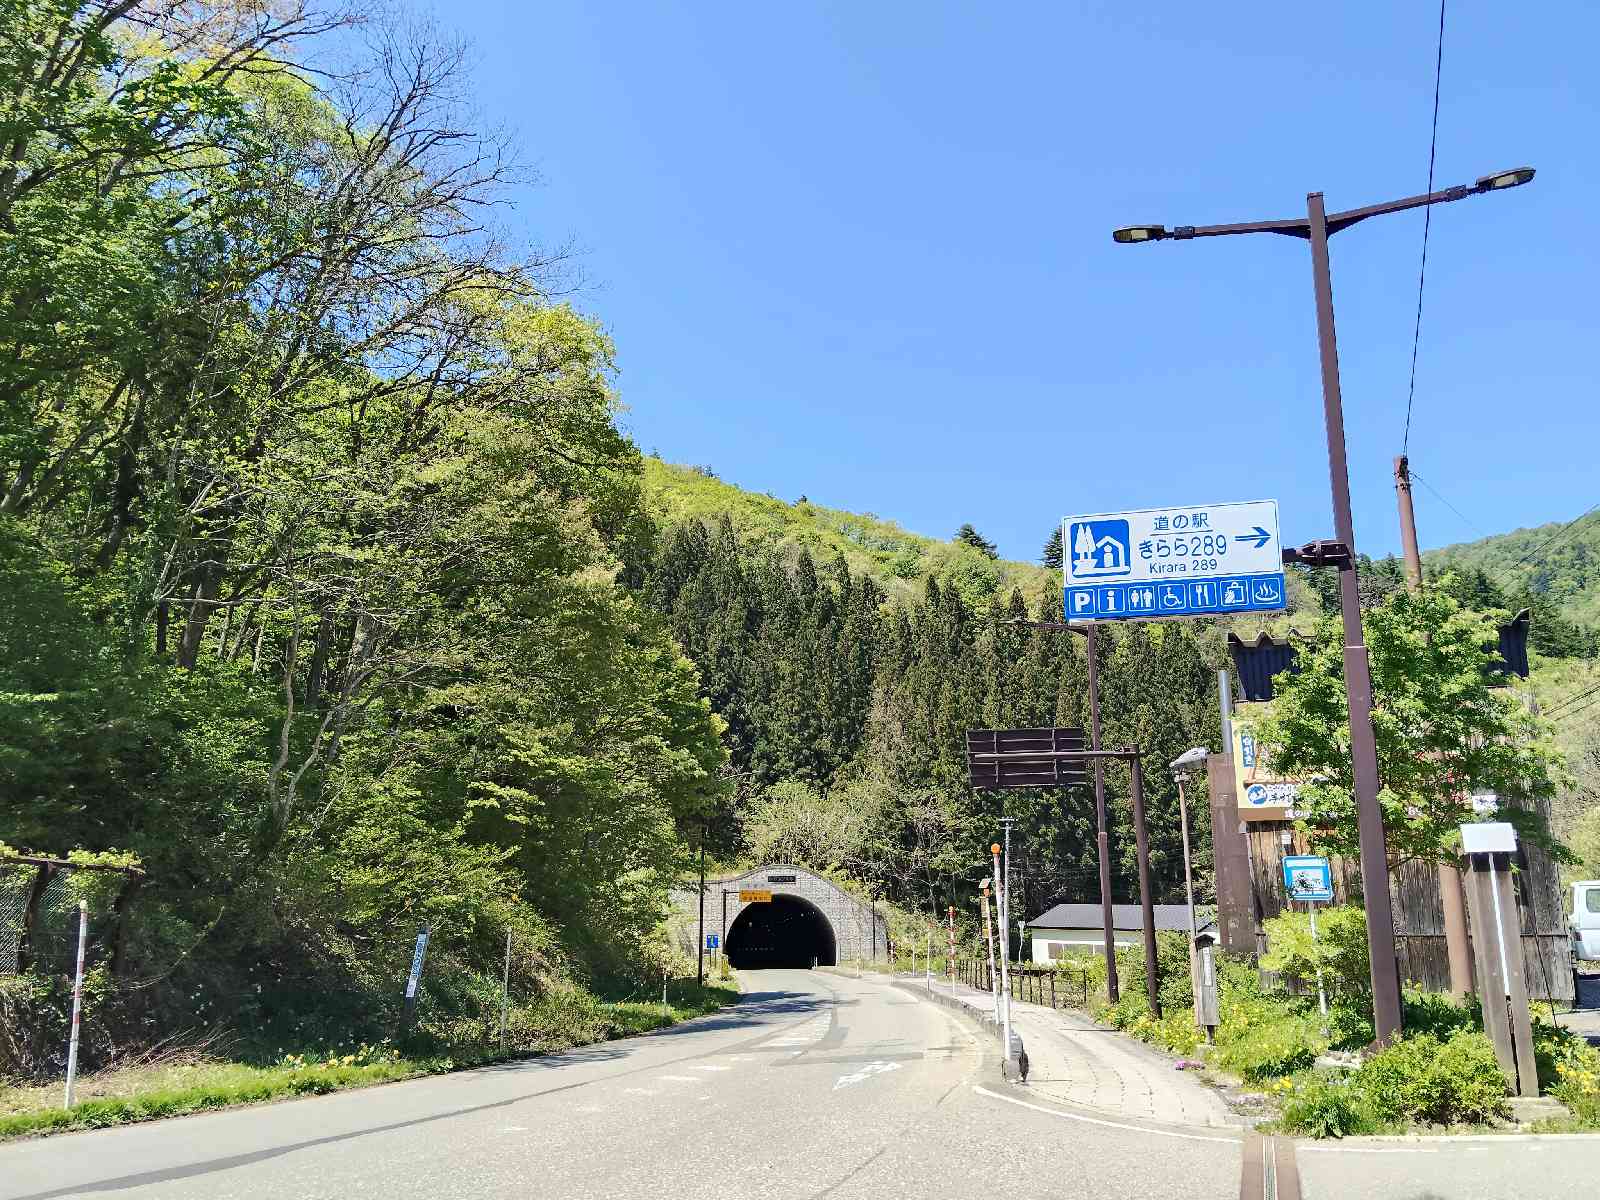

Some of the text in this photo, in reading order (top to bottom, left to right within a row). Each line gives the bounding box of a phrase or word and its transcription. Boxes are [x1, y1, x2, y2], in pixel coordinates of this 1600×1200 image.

[1153, 512, 1209, 531] 道の駅
[1139, 534, 1227, 560] きらら289
[1149, 558, 1218, 574] Kirara 289
[1074, 592, 1090, 612] P
